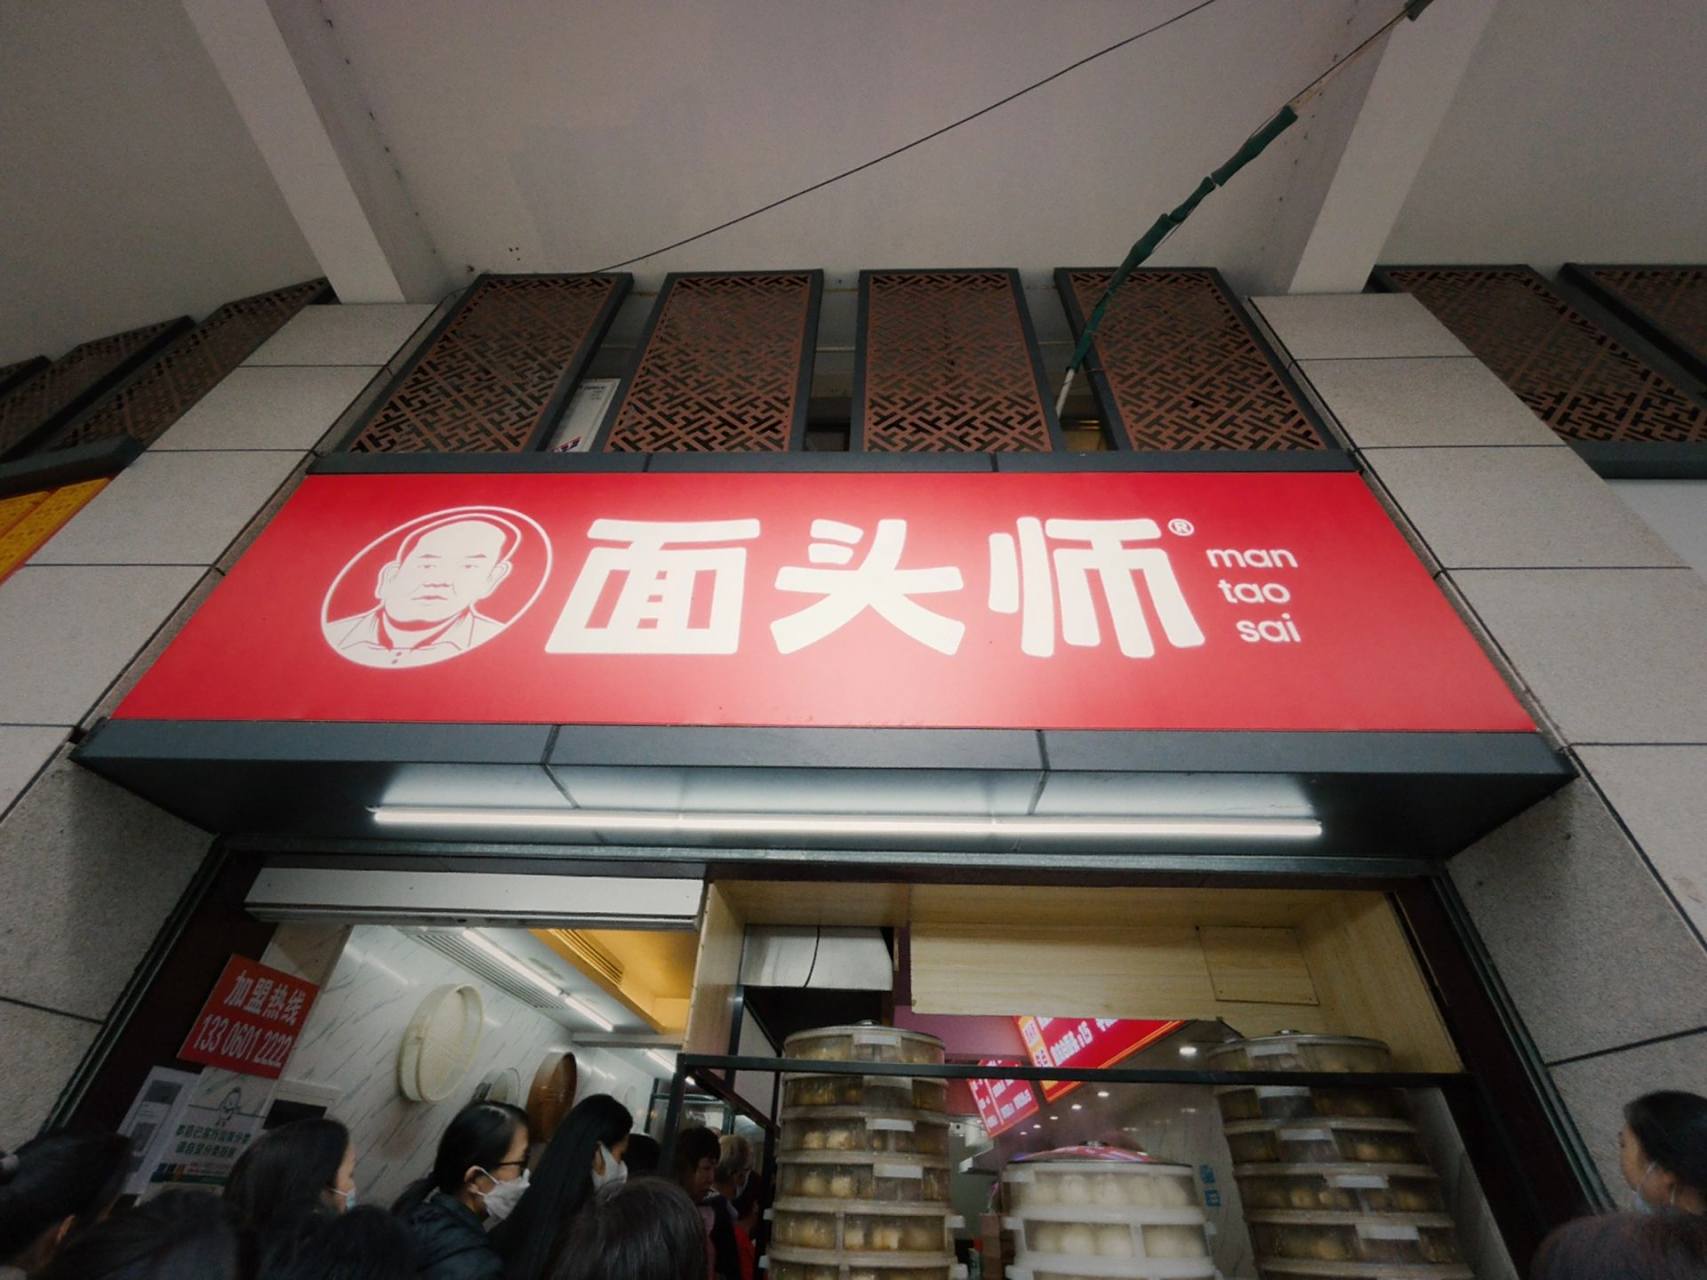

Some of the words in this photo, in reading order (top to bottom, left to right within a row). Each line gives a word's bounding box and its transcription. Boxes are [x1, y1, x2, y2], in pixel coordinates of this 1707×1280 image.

[1205, 548, 1299, 569] man
[544, 516, 1206, 659] 面头师
[1217, 578, 1291, 605] tao
[1235, 612, 1302, 643] sai
[223, 968, 307, 1027] 加盟热线
[193, 1013, 230, 1053] 133
[220, 1020, 264, 1061] 0601
[253, 1029, 293, 1068] 2222
